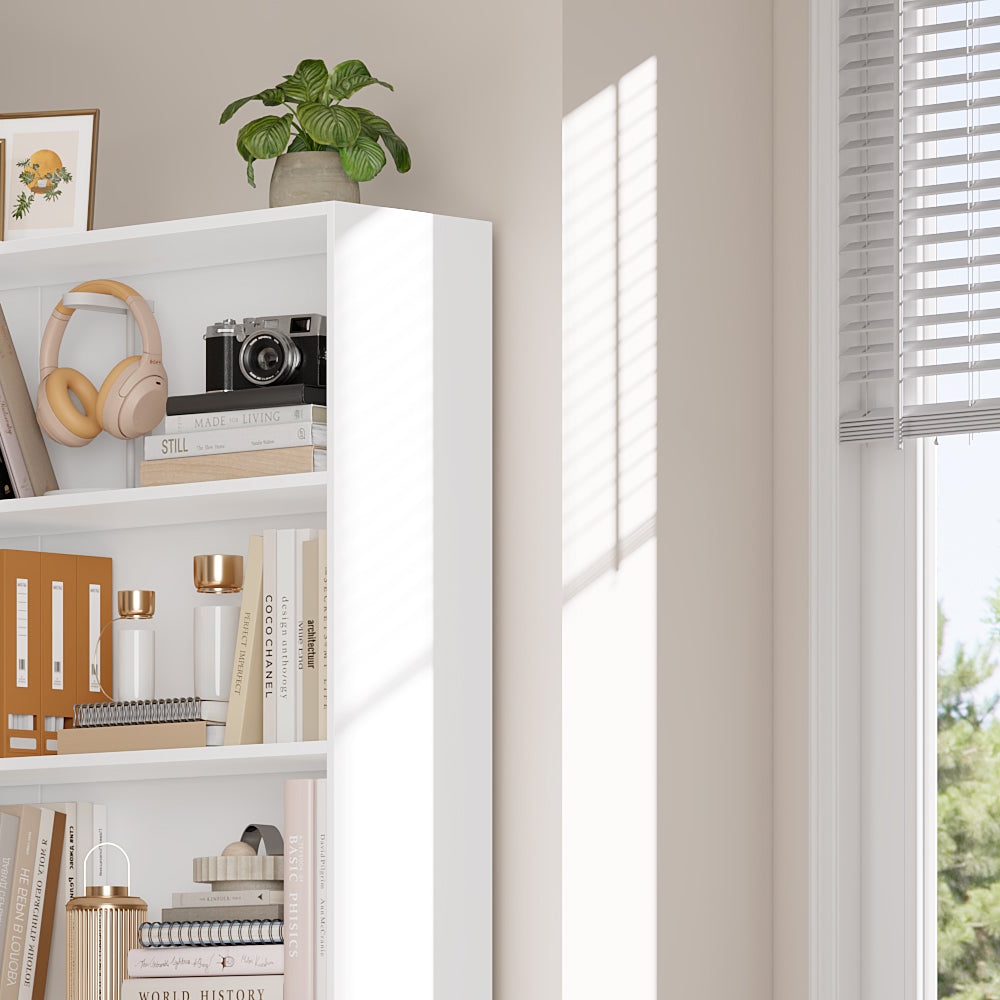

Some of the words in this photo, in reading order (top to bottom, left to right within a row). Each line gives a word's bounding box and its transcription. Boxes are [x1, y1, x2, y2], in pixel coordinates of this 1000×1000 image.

[194, 418, 226, 428] MADE
[243, 411, 281, 423] LIVING
[162, 438, 188, 454] STILL
[240, 612, 251, 648] PERFECT
[281, 596, 289, 636] design
[307, 620, 316, 669] architectuur
[234, 651, 246, 696] IMPERFECT
[280, 640, 289, 700] anthology
[288, 835, 299, 884] BASIC
[288, 894, 299, 958] PHISICS
